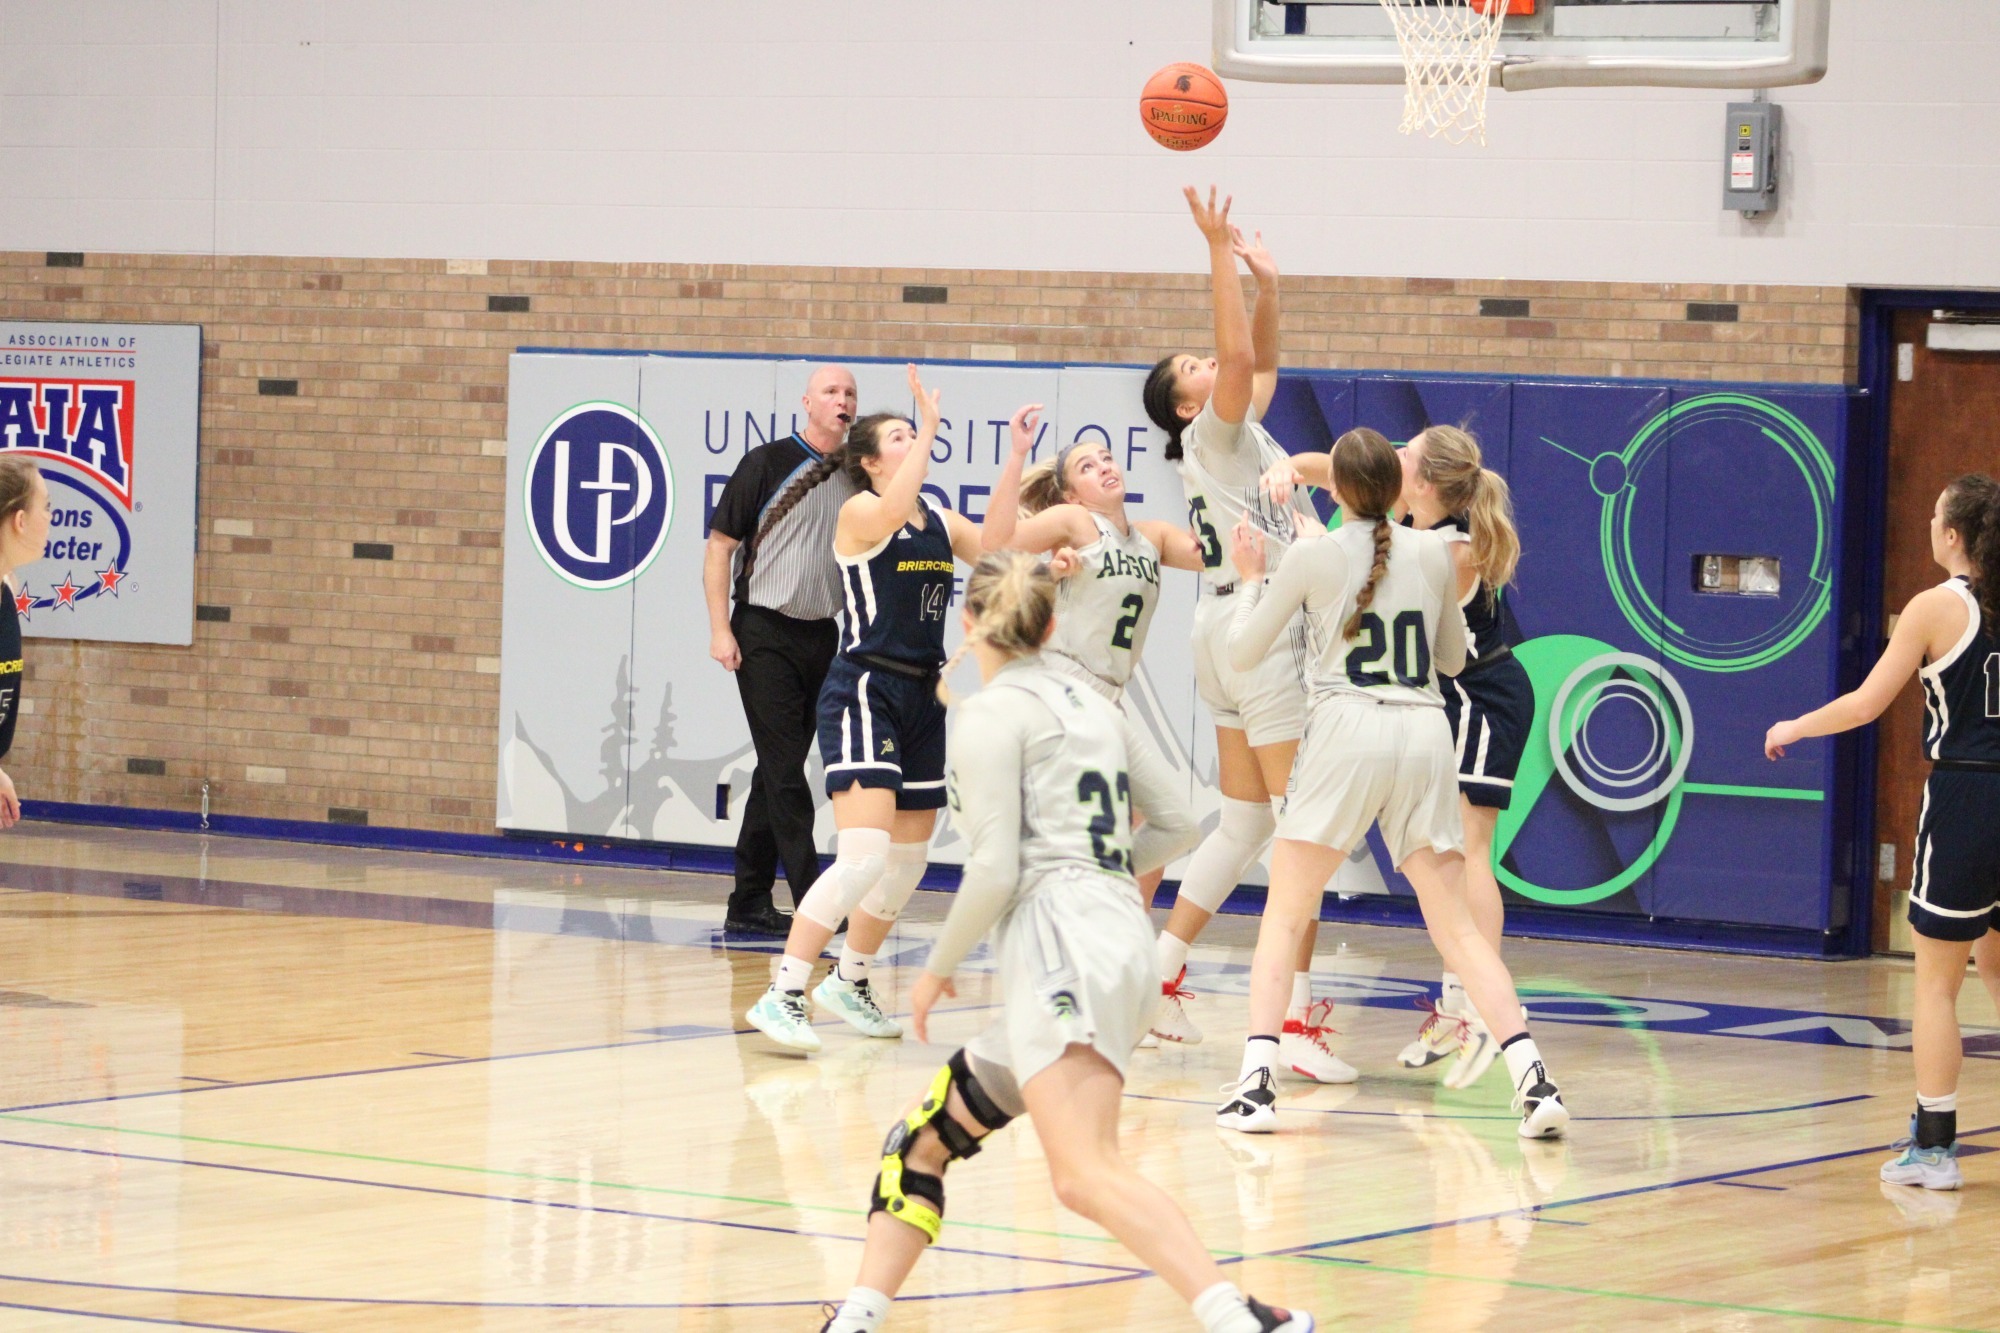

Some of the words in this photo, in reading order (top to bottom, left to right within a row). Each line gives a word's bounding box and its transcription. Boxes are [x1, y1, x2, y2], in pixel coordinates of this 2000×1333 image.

[1151, 107, 1207, 126] SPALDING
[9, 335, 109, 347] ASSOCIATION
[118, 338, 136, 347] OF
[0, 354, 52, 366] EGIATE
[60, 356, 136, 368] ATHLETICS
[920, 583, 944, 621] 14
[1111, 593, 1144, 650] 2
[1345, 610, 1431, 689] 20
